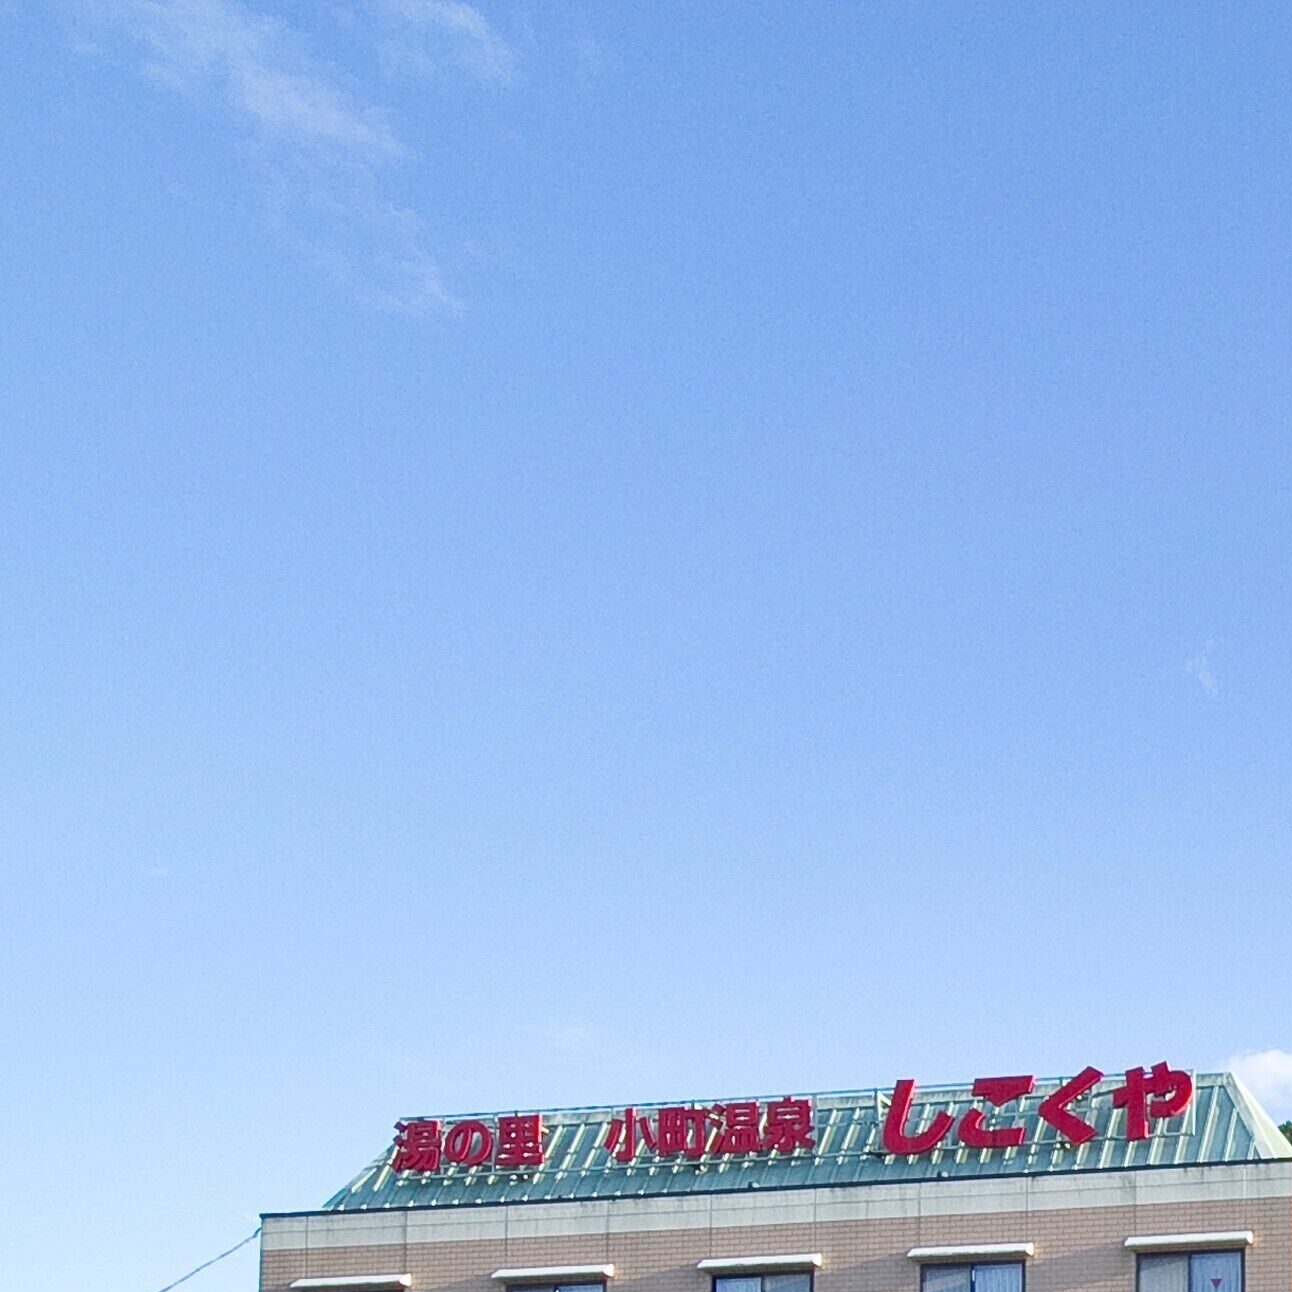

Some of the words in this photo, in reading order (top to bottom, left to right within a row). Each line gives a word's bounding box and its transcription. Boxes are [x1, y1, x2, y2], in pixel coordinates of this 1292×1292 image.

[392, 1113, 545, 1173] 湯の里
[603, 1096, 816, 1162] 小町温泉
[882, 1060, 1195, 1156] しこくや
